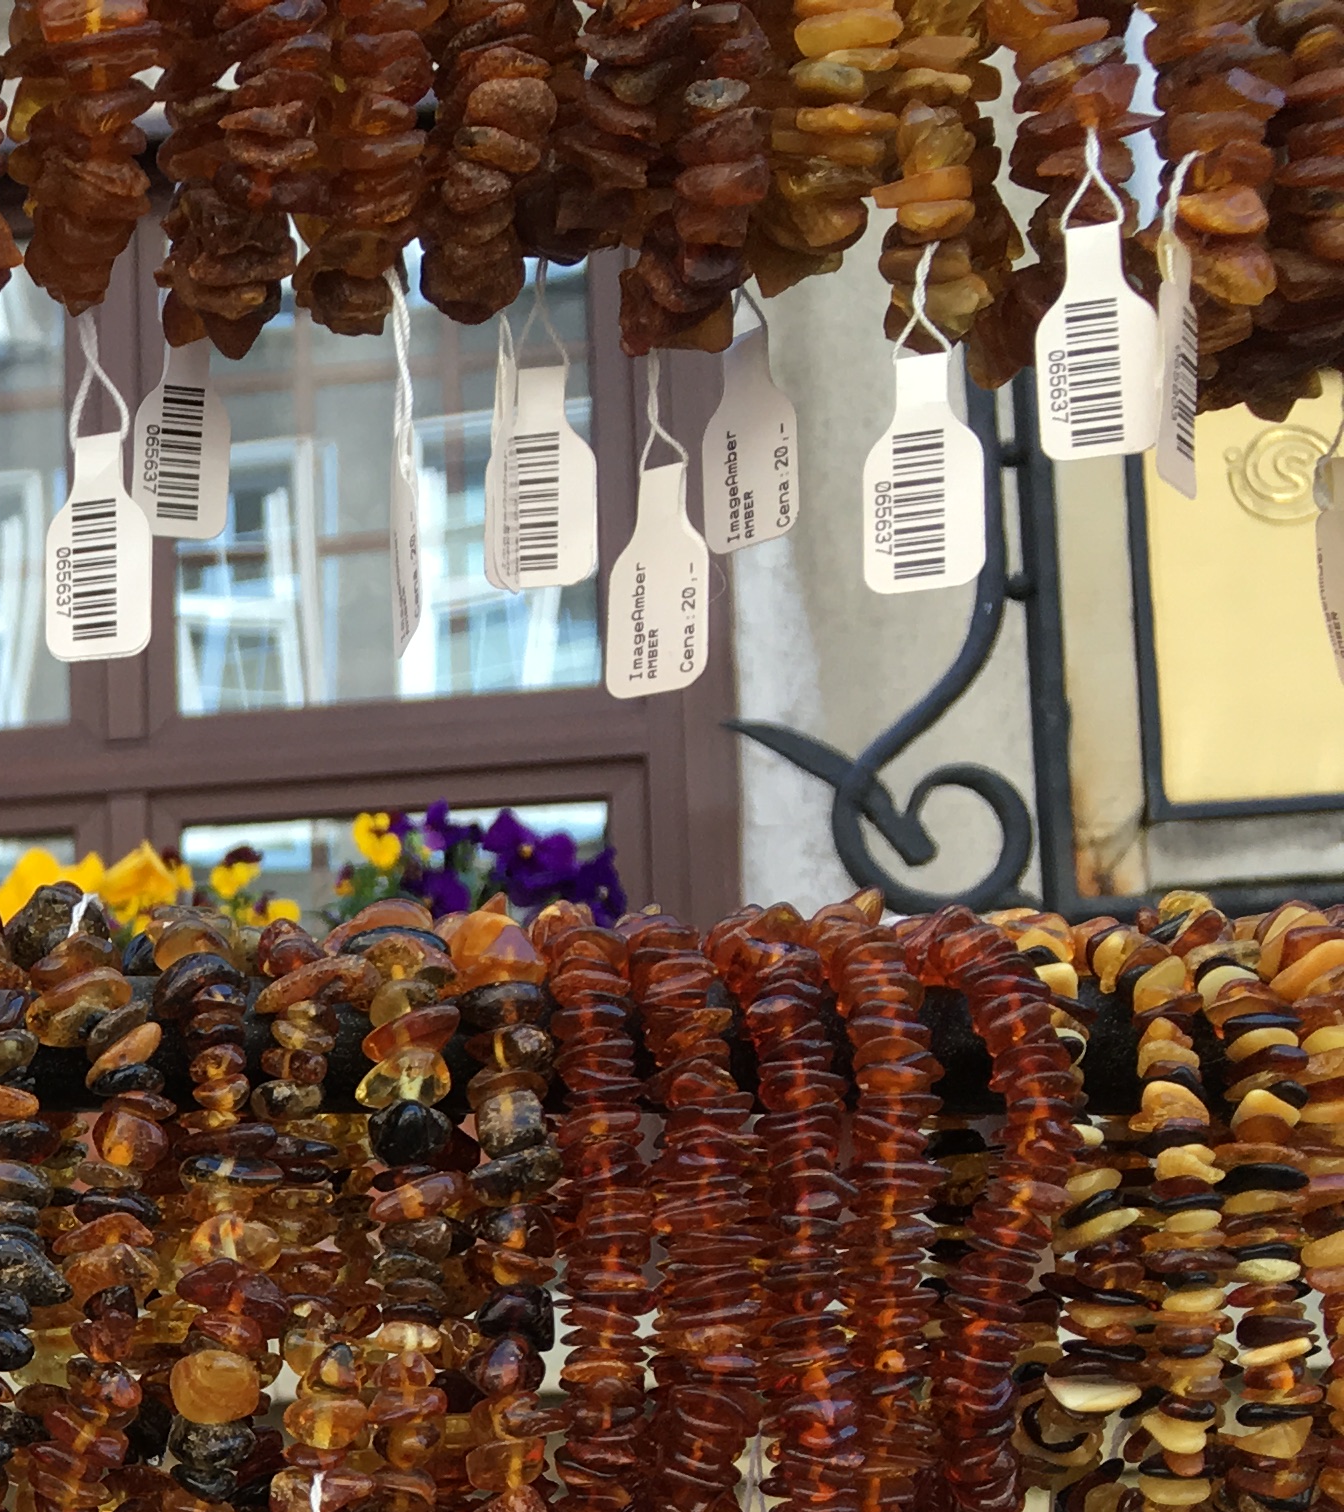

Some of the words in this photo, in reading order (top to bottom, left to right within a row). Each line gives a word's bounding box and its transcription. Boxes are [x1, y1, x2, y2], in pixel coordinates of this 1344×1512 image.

[1048, 349, 1069, 425] 065637
[142, 424, 161, 495] 065637
[726, 431, 740, 544] ImageAmber
[744, 489, 756, 540] AMBER
[875, 480, 893, 557] 065637
[56, 547, 71, 617] 065637
[629, 561, 645, 679] ImageAmber
[647, 627, 658, 679] AMBER
